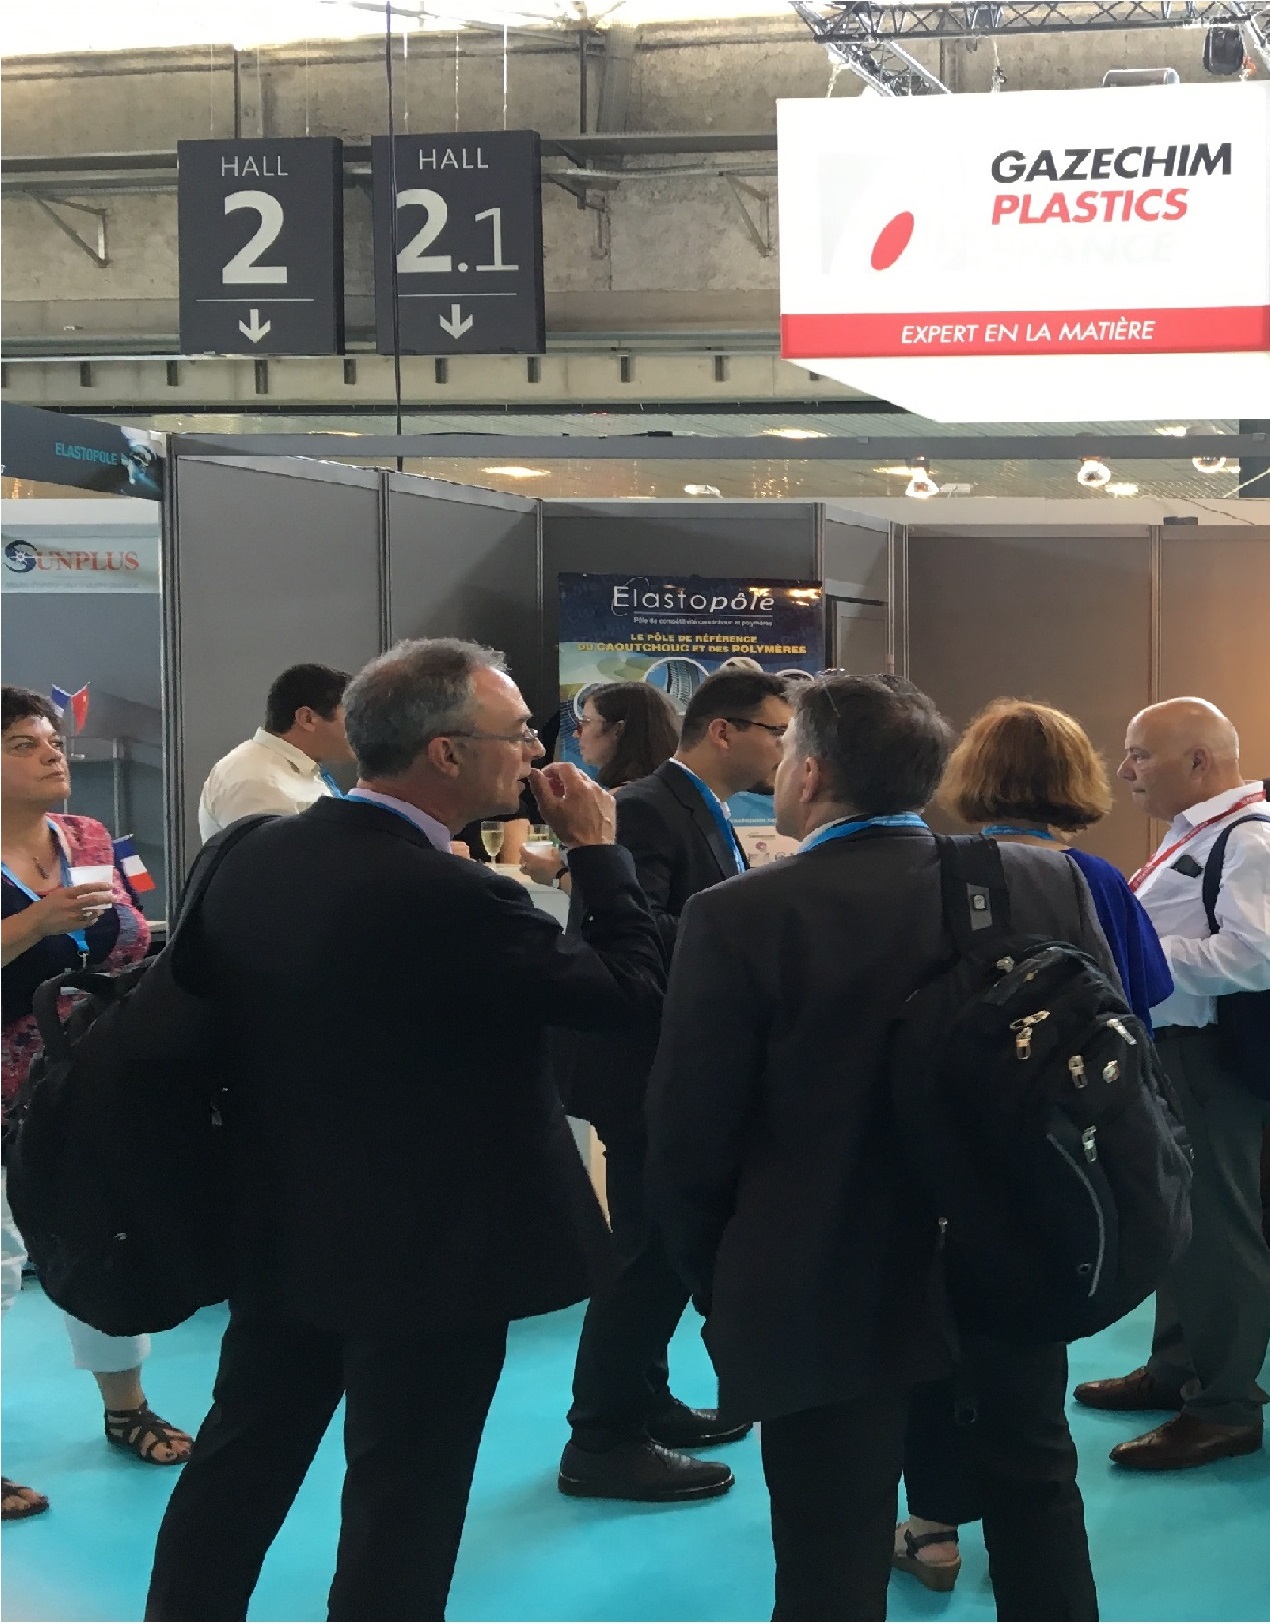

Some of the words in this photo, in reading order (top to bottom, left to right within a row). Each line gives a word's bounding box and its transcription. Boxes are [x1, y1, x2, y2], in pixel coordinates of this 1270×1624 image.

[221, 155, 289, 177] HALL
[420, 147, 489, 170] HALL
[991, 142, 1232, 184] GAZECHIM
[992, 187, 1189, 225] PLASTICS
[222, 190, 288, 284] 2
[396, 188, 519, 274] 2.1
[902, 325, 980, 344] EXPERT
[984, 323, 1019, 343] EN
[1026, 323, 1052, 342] LA
[1058, 316, 1156, 341] MATIÈRE
[612, 584, 776, 613] Elastopôle
[630, 633, 645, 641] LE
